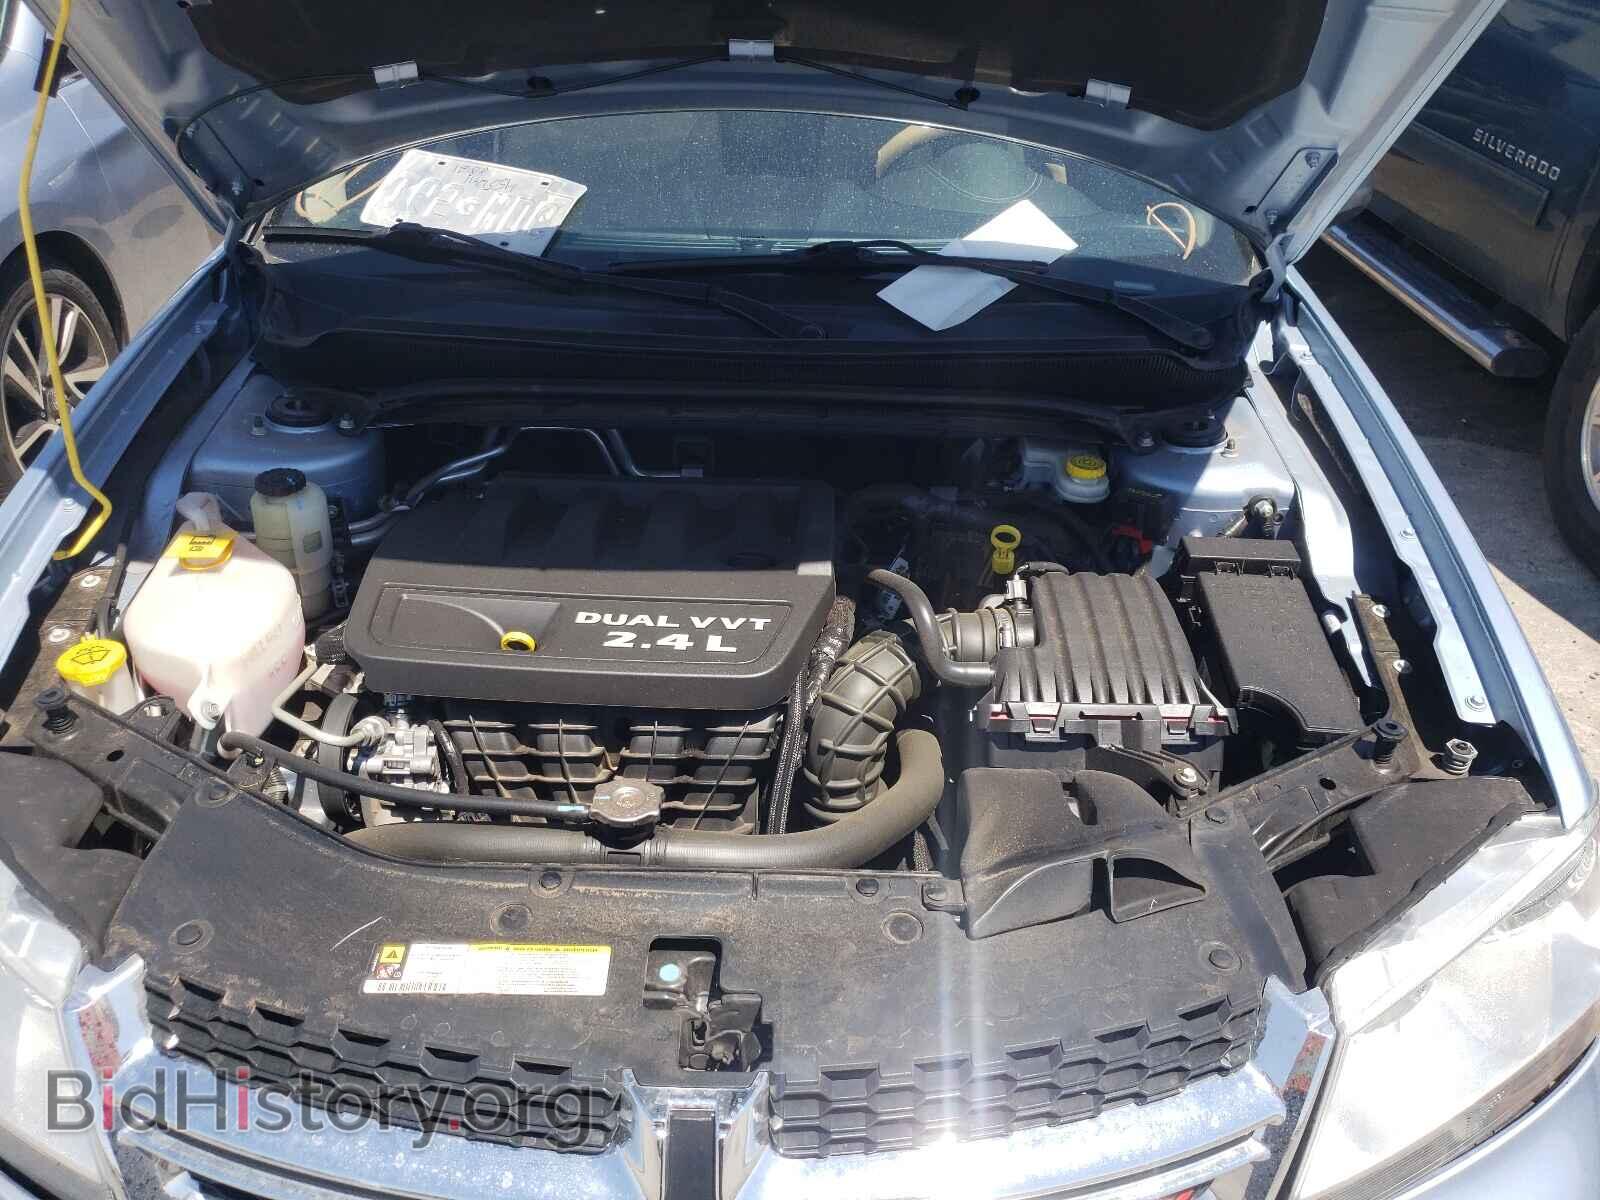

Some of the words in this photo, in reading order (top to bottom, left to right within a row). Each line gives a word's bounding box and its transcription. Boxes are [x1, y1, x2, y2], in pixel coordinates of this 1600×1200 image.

[1472, 127, 1561, 182] SILVERADO
[574, 611, 680, 628] DUAL
[690, 616, 772, 631] VVT
